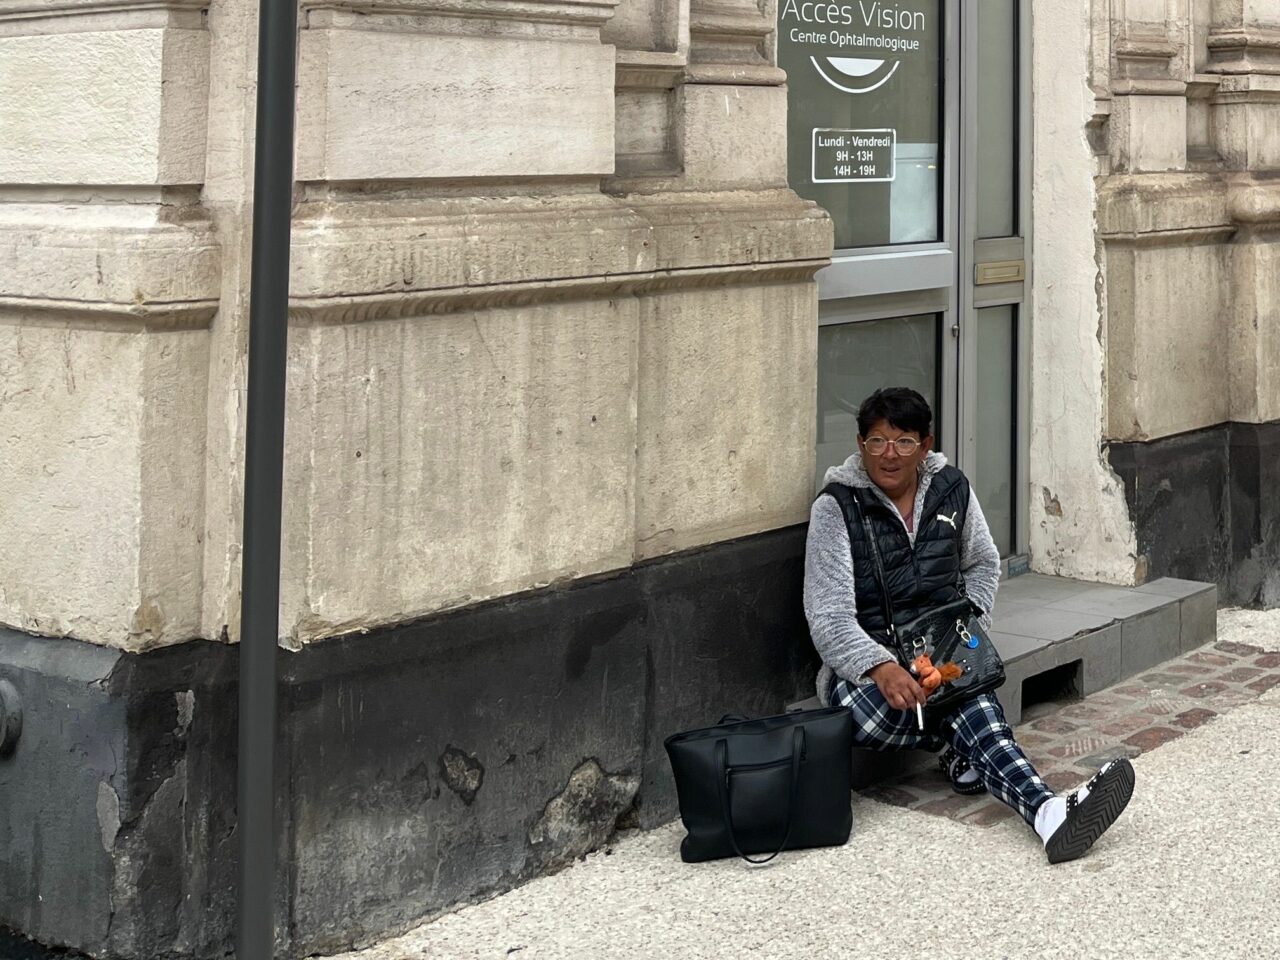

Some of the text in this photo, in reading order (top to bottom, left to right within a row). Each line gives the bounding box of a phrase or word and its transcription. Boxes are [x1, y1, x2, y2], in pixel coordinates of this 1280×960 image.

[859, 0, 925, 31] Vision
[790, 28, 920, 51] Centre Ophtalmologique
[818, 136, 845, 147] Lundi
[852, 136, 891, 147] Vendredi
[836, 151, 849, 161] 9H
[856, 151, 873, 161] 13H
[833, 165, 851, 176] 14H
[859, 165, 876, 176] 19H
